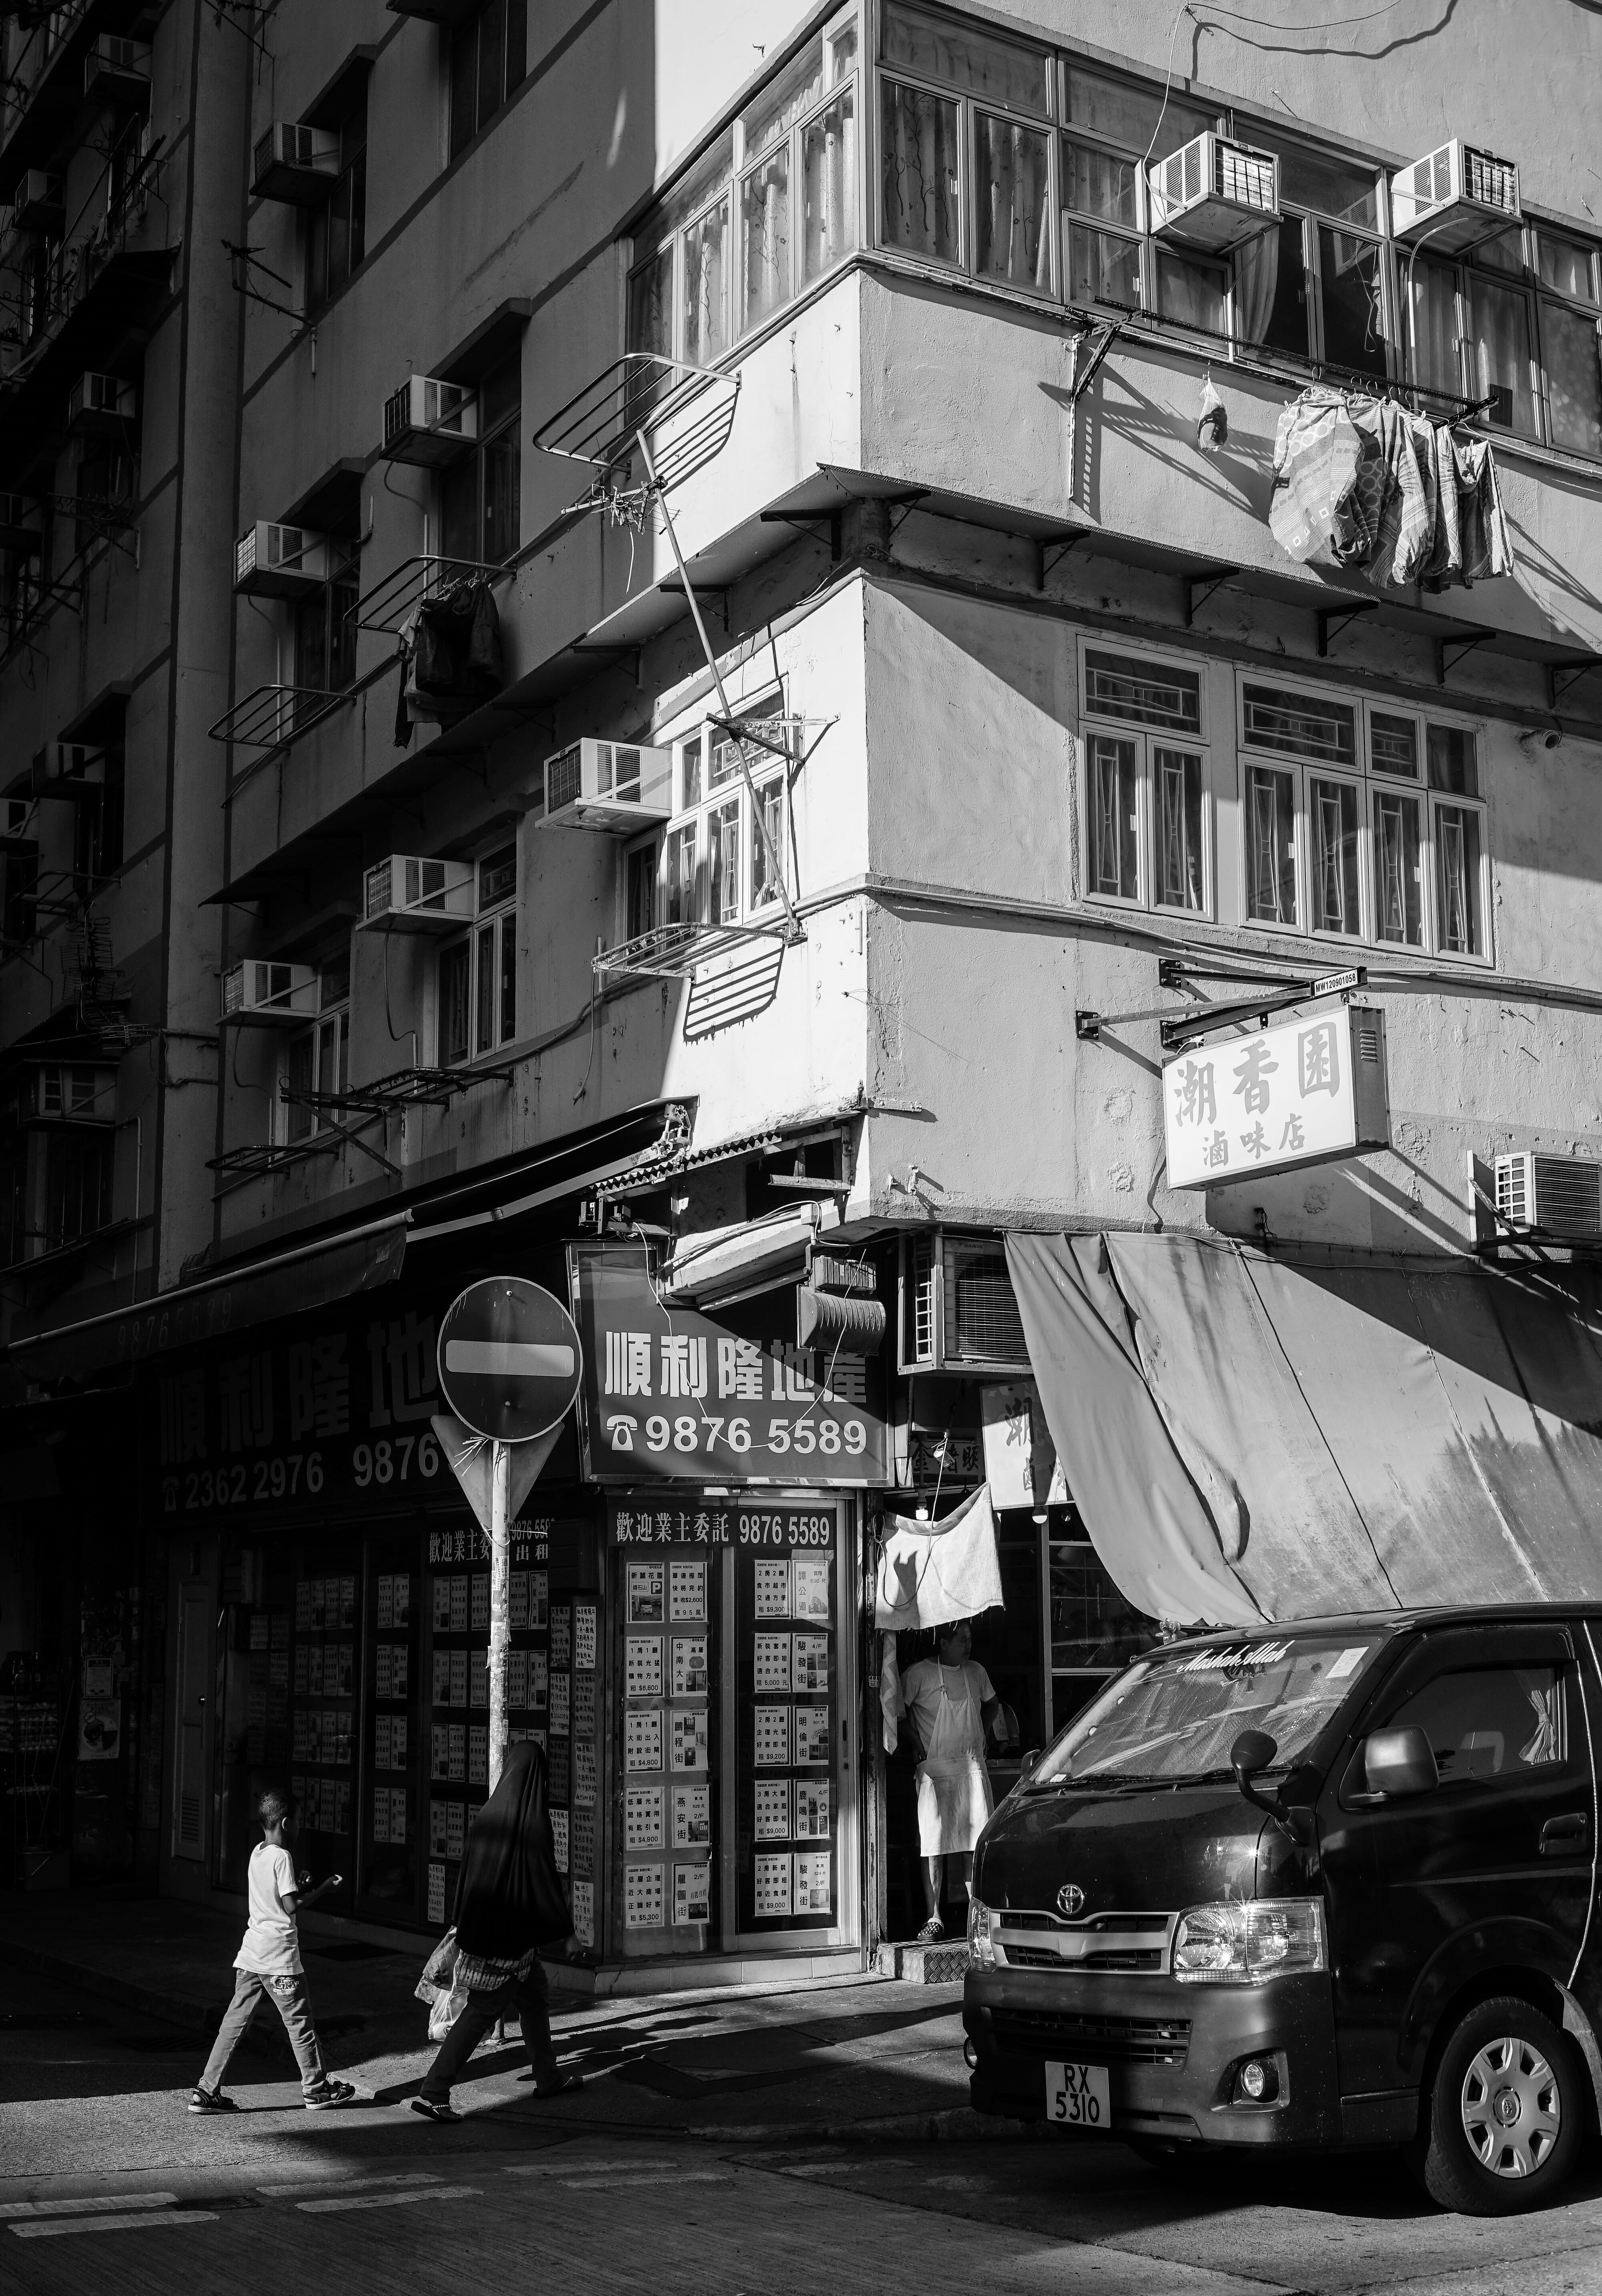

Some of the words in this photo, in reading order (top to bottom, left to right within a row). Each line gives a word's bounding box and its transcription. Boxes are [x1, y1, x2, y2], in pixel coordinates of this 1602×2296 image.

[1315, 972, 1356, 993] MW120901058
[1174, 1021, 1340, 1127] 潮香園
[1203, 1113, 1305, 1168] 滷味店
[604, 1331, 867, 1403] 順利隆地產
[645, 1415, 752, 1453] 9876
[768, 1418, 867, 1455] 5589
[185, 1464, 247, 1510] 2362
[253, 1451, 324, 1500] 2976
[352, 1432, 439, 1487] 9876
[511, 1520, 532, 1541] 9876
[616, 1512, 730, 1543] 歡迎業主委託
[739, 1514, 782, 1544] 9876
[788, 1516, 831, 1546] 5589
[516, 1544, 548, 1561] 出租
[798, 1641, 806, 1684] 駿發街
[675, 1722, 683, 1763] 鵬程街
[799, 1717, 807, 1757] 明倫街
[677, 1797, 686, 1839] 燕安街
[799, 1791, 807, 1831] 鹿鳴街
[1064, 2064, 1091, 2095] RX
[1055, 2091, 1100, 2123] 5310
